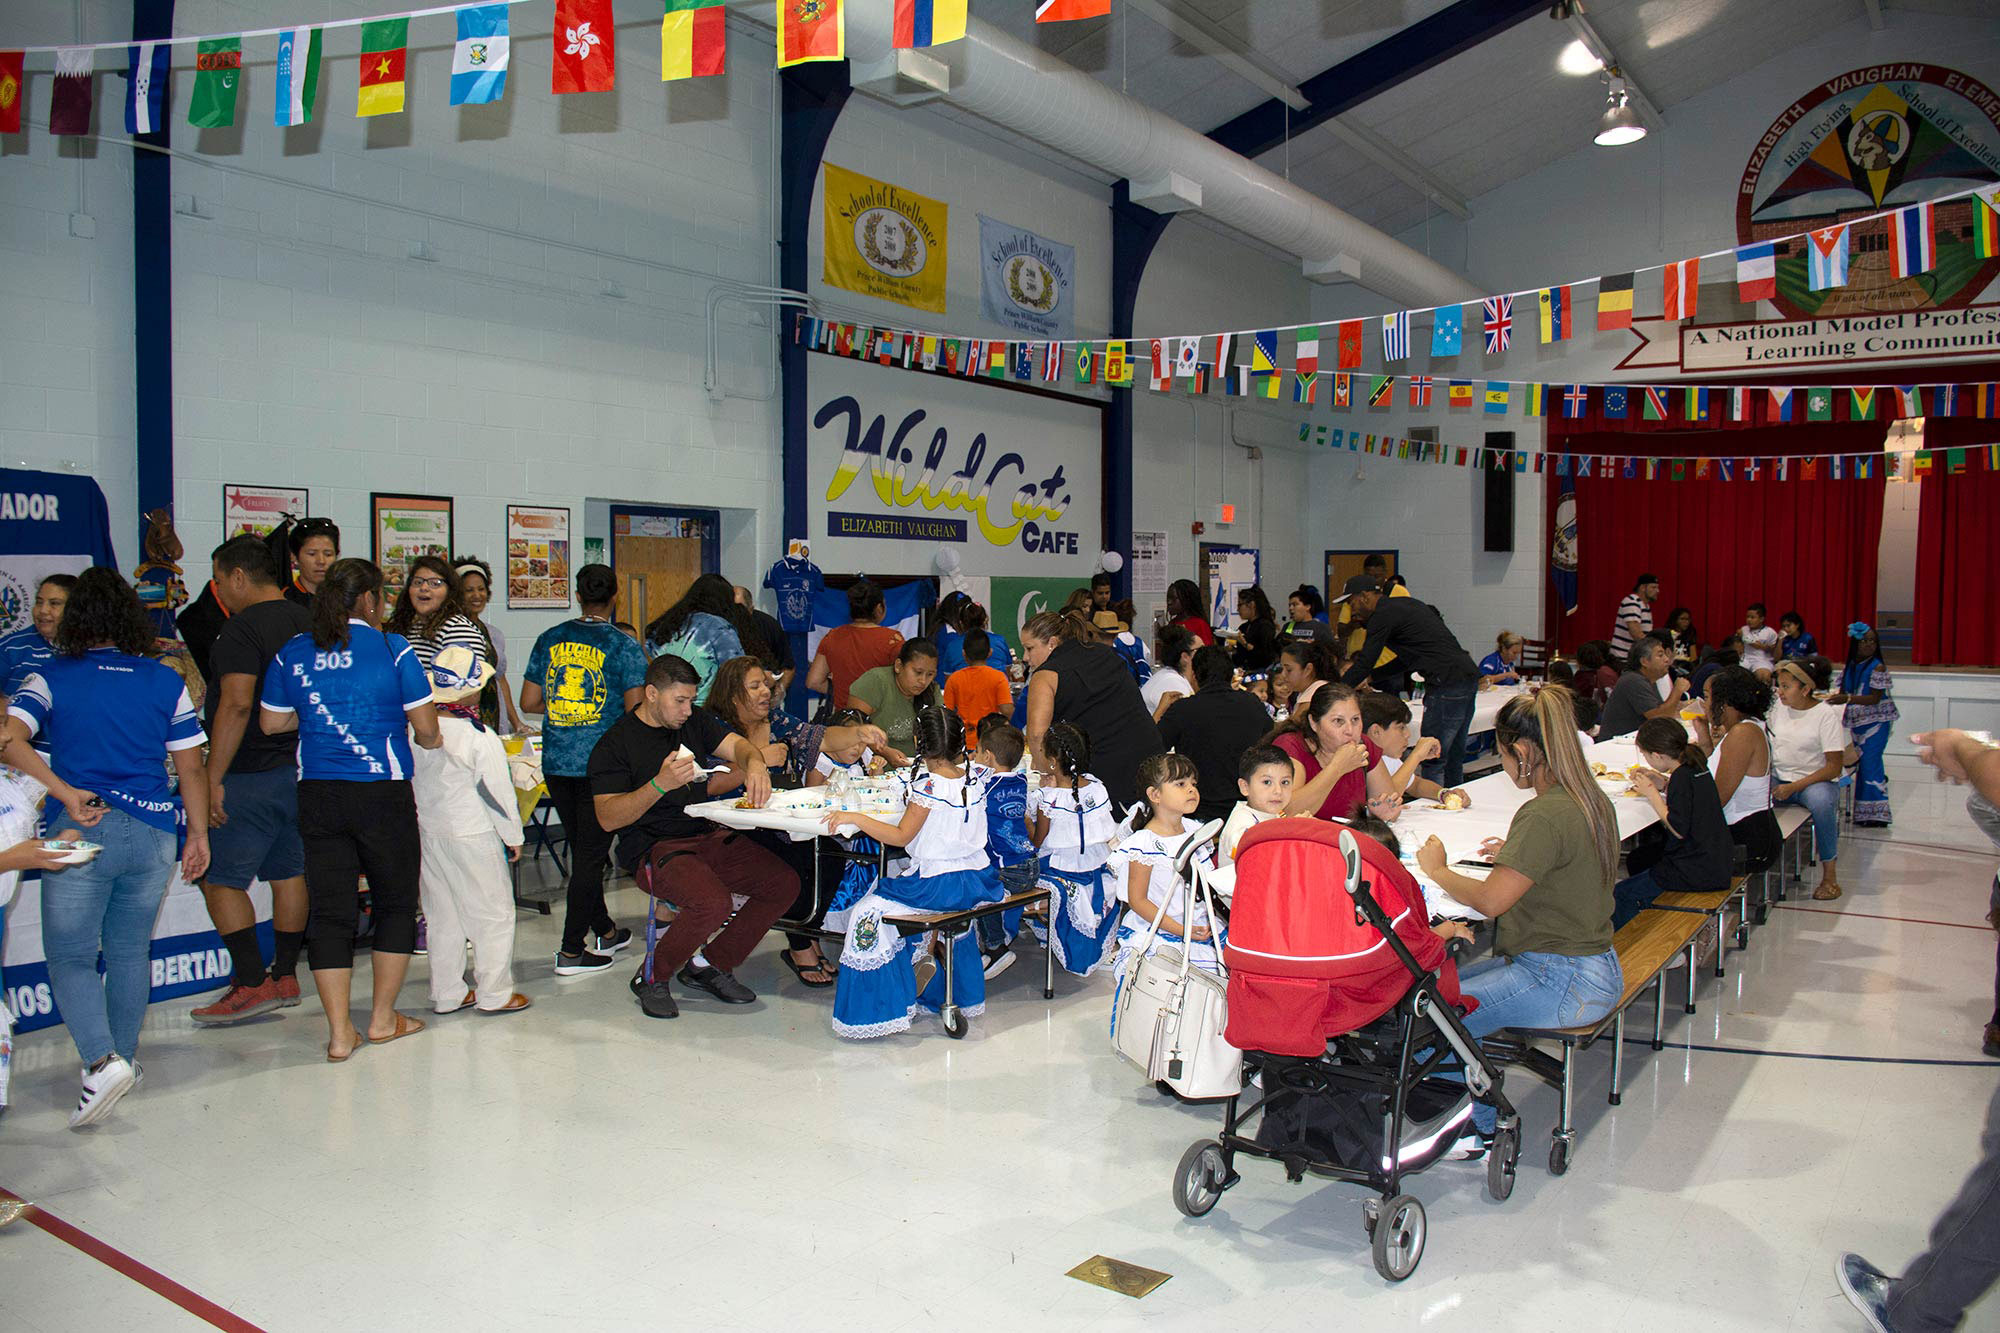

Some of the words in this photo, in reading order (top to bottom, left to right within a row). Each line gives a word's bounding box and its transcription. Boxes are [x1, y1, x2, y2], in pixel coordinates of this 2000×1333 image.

[1896, 82, 1939, 121] School
[1935, 113, 1953, 129] of
[1742, 102, 1806, 195] ELIZABETH
[1826, 65, 1925, 96] VAUGHAN
[1783, 141, 1812, 169] High
[1810, 101, 1853, 141] Flying
[839, 185, 876, 225] School
[876, 186, 888, 207] of
[889, 186, 938, 248] Excellence
[991, 234, 1020, 269] School
[1020, 234, 1029, 253] of
[1030, 235, 1068, 289] Excellence
[857, 270, 876, 282] Prince
[877, 275, 899, 289] William
[900, 281, 922, 296] County
[867, 284, 888, 297] Public
[1003, 307, 1020, 319] Prince
[1013, 320, 1030, 331] Public
[1689, 329, 1710, 345] A
[1716, 319, 1818, 344] National
[1826, 313, 1905, 335] Model
[1915, 307, 2000, 328] Profes
[1745, 338, 1857, 361] Learning
[813, 395, 1072, 547] WildCat
[0, 492, 60, 522] ADOR
[841, 517, 902, 534] ELIZABETH
[907, 521, 957, 538] VAUGHAN
[1021, 521, 1079, 555] CAFE
[313, 650, 353, 671] 503
[549, 641, 607, 669] VAUGHAN
[292, 663, 313, 688] EL
[309, 691, 385, 774] SALVADOR
[151, 947, 234, 988] BERTAD
[7, 982, 54, 1019] IOS
